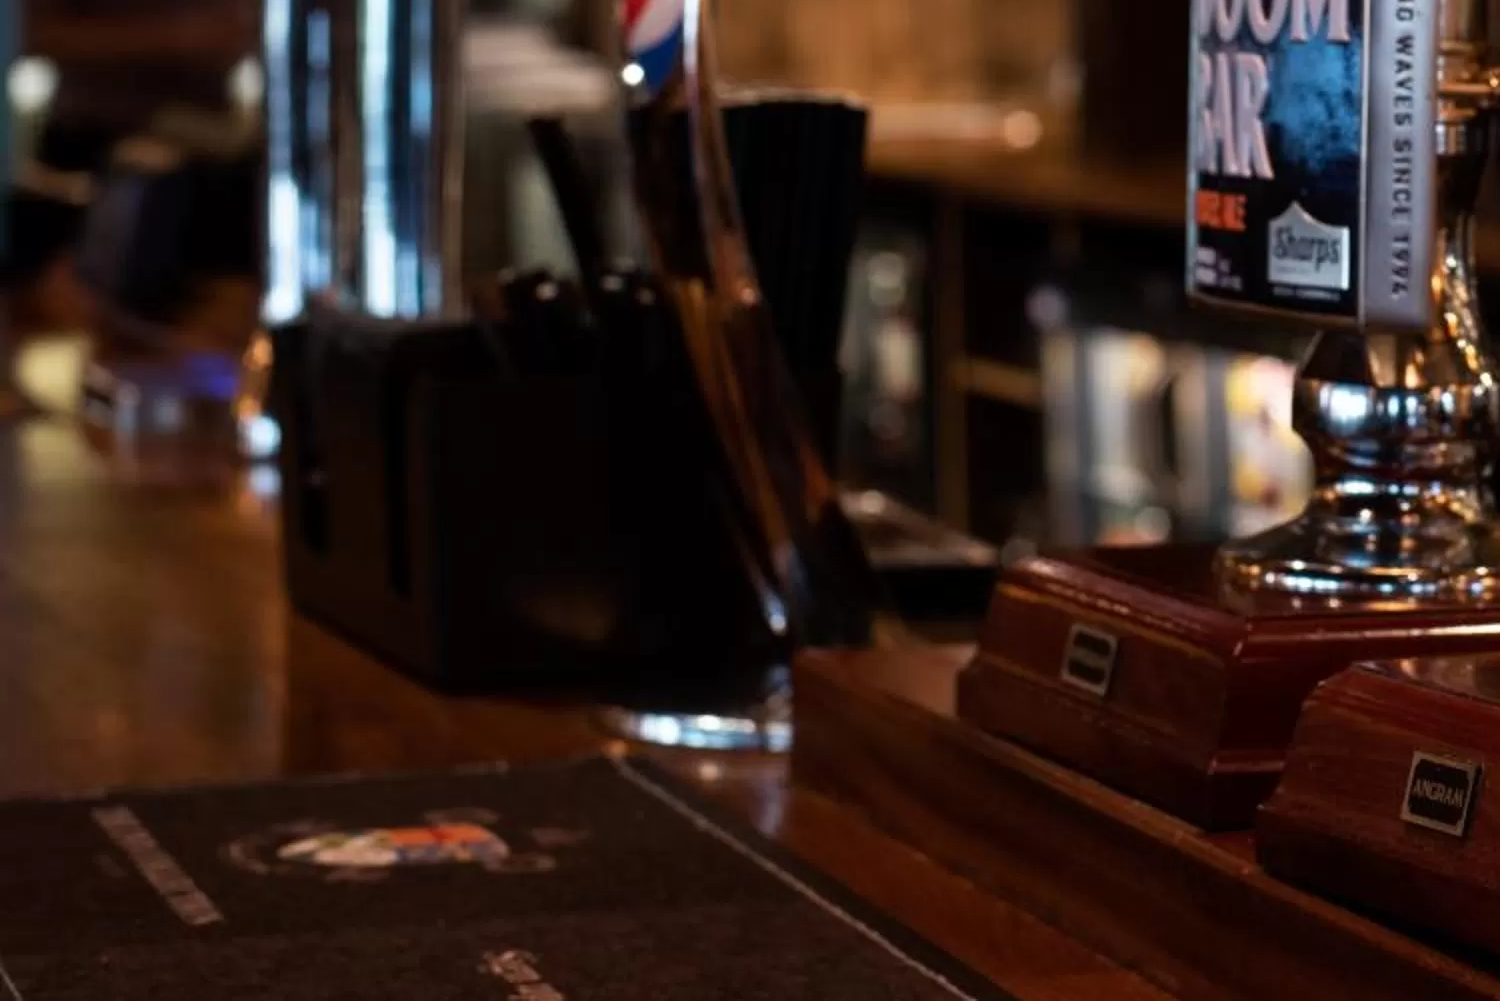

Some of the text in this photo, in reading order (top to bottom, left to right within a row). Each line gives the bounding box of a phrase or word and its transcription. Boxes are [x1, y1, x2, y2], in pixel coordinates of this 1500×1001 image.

[1393, 34, 1416, 127] WAVES
[1391, 138, 1415, 217] SINCE
[1390, 232, 1414, 297] 1994
